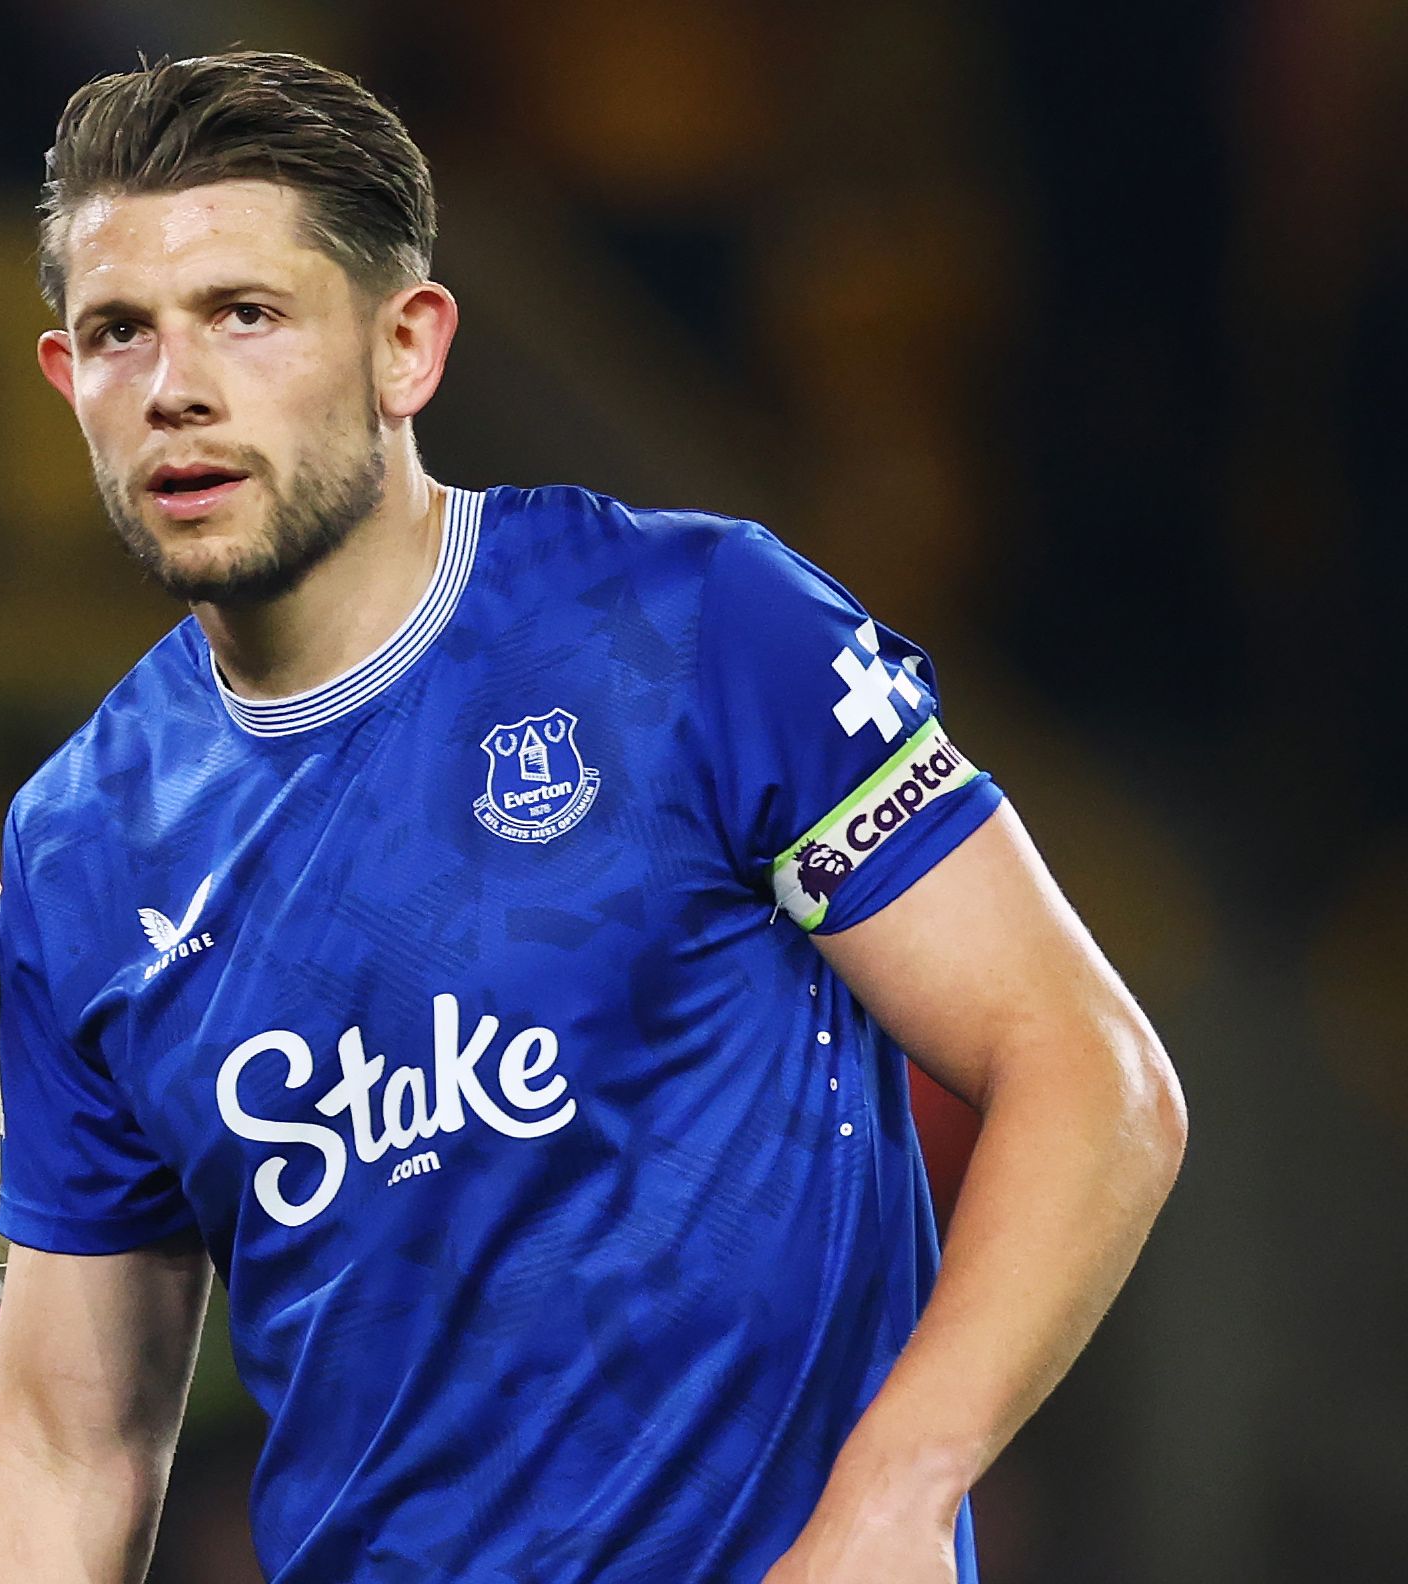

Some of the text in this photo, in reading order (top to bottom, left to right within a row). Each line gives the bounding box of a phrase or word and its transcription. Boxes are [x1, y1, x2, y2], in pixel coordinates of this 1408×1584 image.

[503, 781, 573, 810] Everton
[215, 993, 577, 1227] Stake
[387, 1150, 442, 1187] .com
